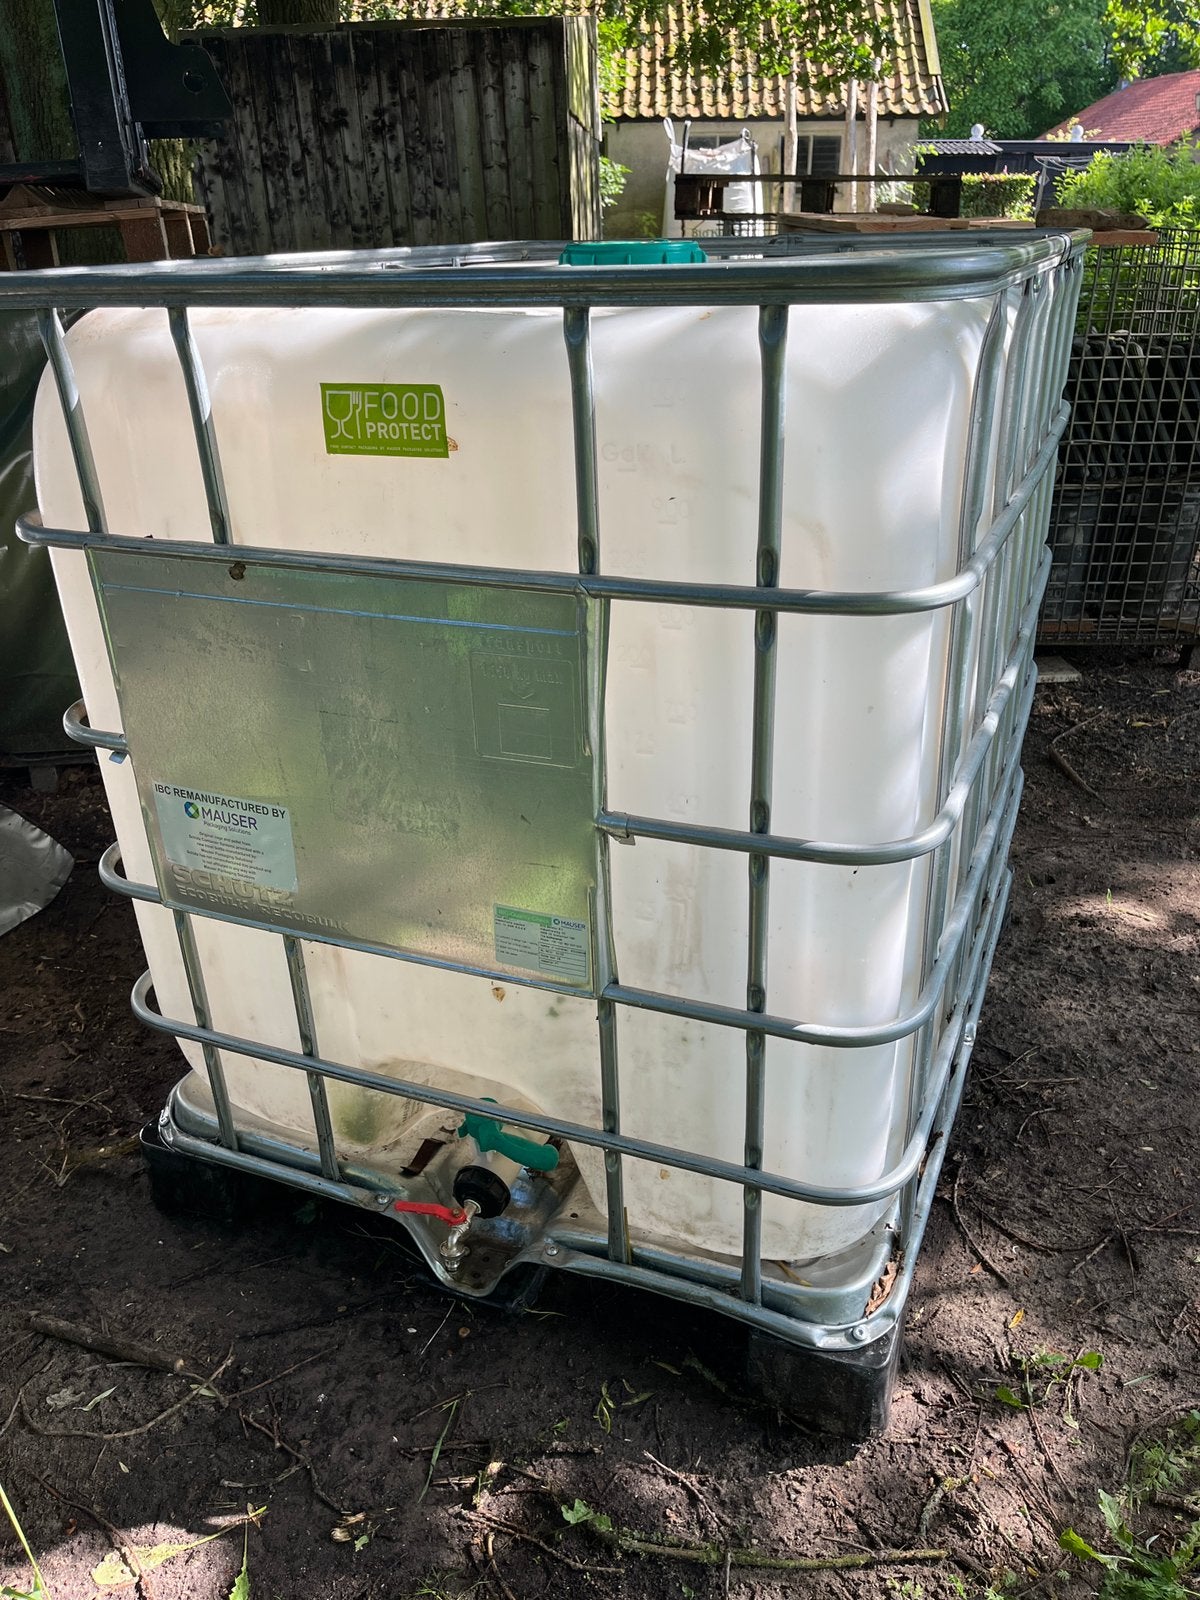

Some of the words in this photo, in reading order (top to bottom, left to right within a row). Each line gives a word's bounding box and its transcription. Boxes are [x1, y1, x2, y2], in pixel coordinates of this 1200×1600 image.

[365, 391, 441, 421] FOOD
[366, 421, 442, 441] PROTECT
[155, 783, 171, 796] IBC
[173, 788, 269, 816] REMANUFACTURED
[272, 808, 286, 820] BY
[201, 806, 258, 831] MAUSER
[176, 883, 250, 910] ECOBULK
[560, 919, 586, 930] MAUSER
